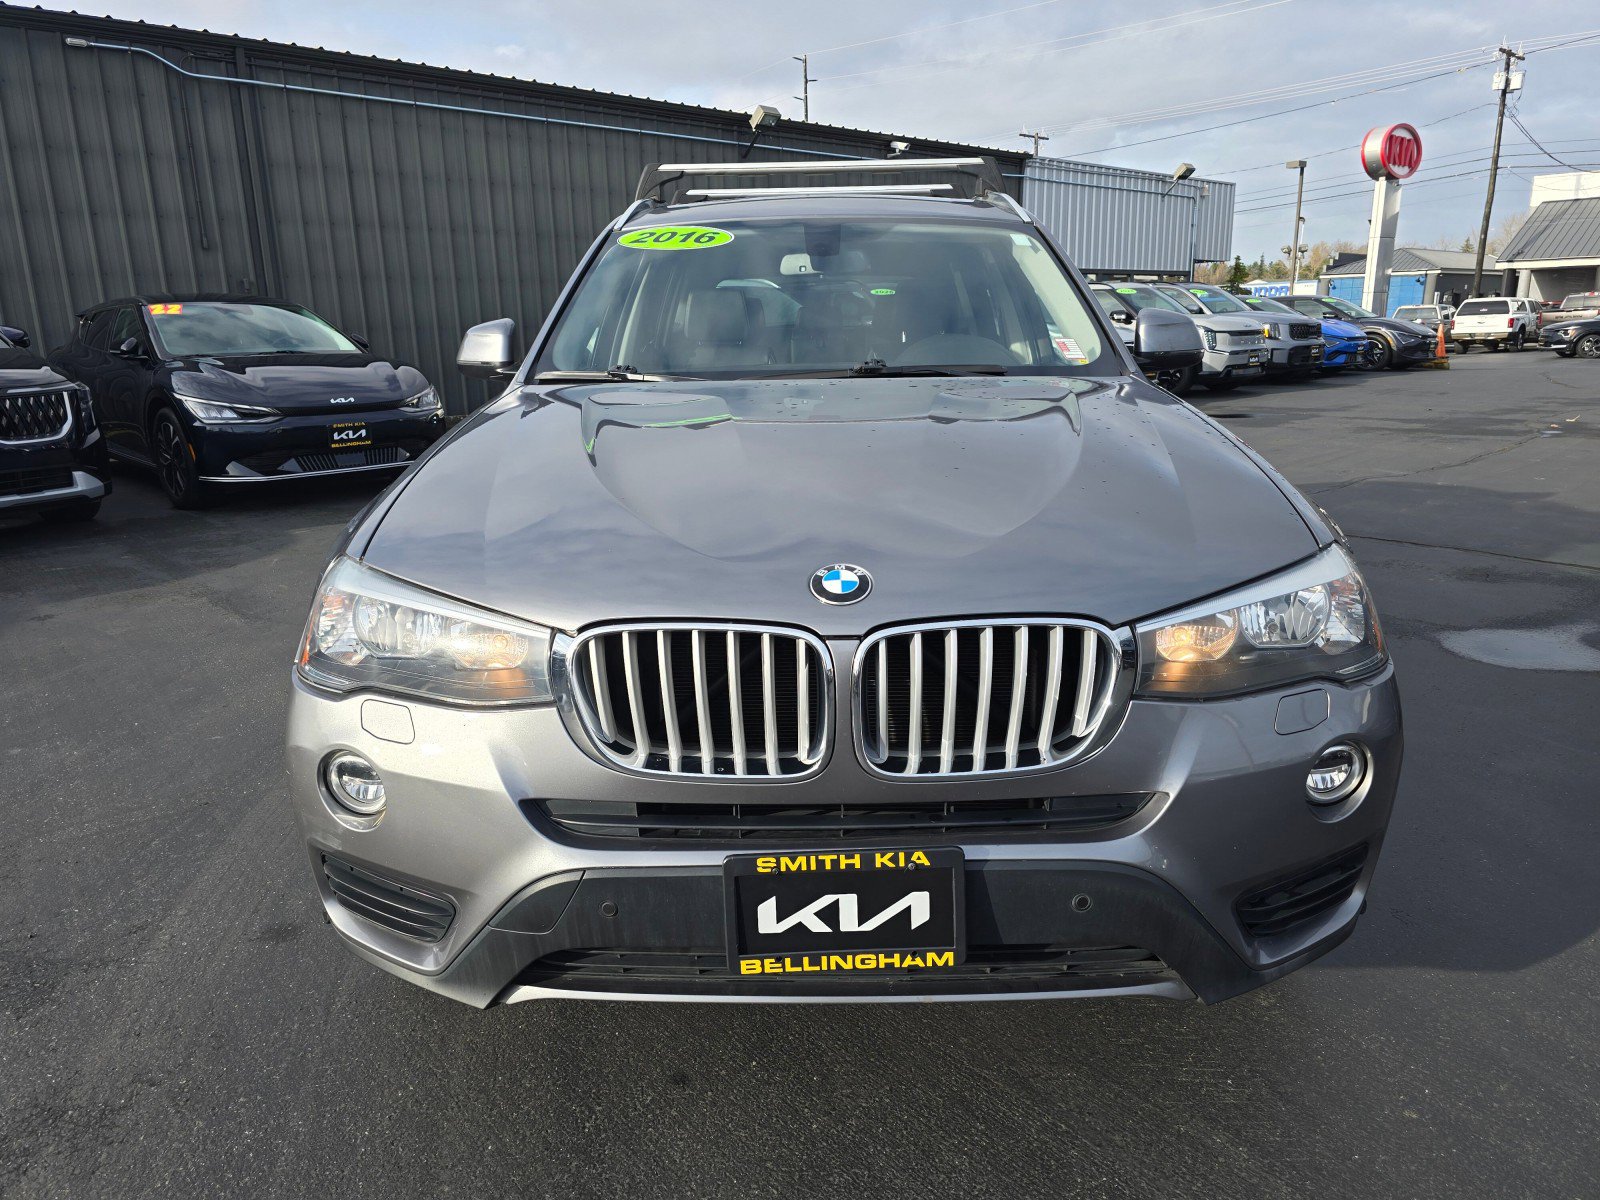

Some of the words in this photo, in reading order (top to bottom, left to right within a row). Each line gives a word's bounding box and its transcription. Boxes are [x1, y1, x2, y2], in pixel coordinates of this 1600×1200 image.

[1387, 134, 1415, 169] KIA
[628, 231, 720, 244] 2016
[149, 303, 181, 315] 22
[333, 428, 366, 440] KIA
[331, 440, 371, 448] BELLINGHAM
[816, 564, 865, 577] BMW
[756, 853, 861, 873] SMITH
[875, 850, 931, 868] KIA
[757, 891, 930, 934] KIA
[740, 951, 954, 975] BELLINGHAM
